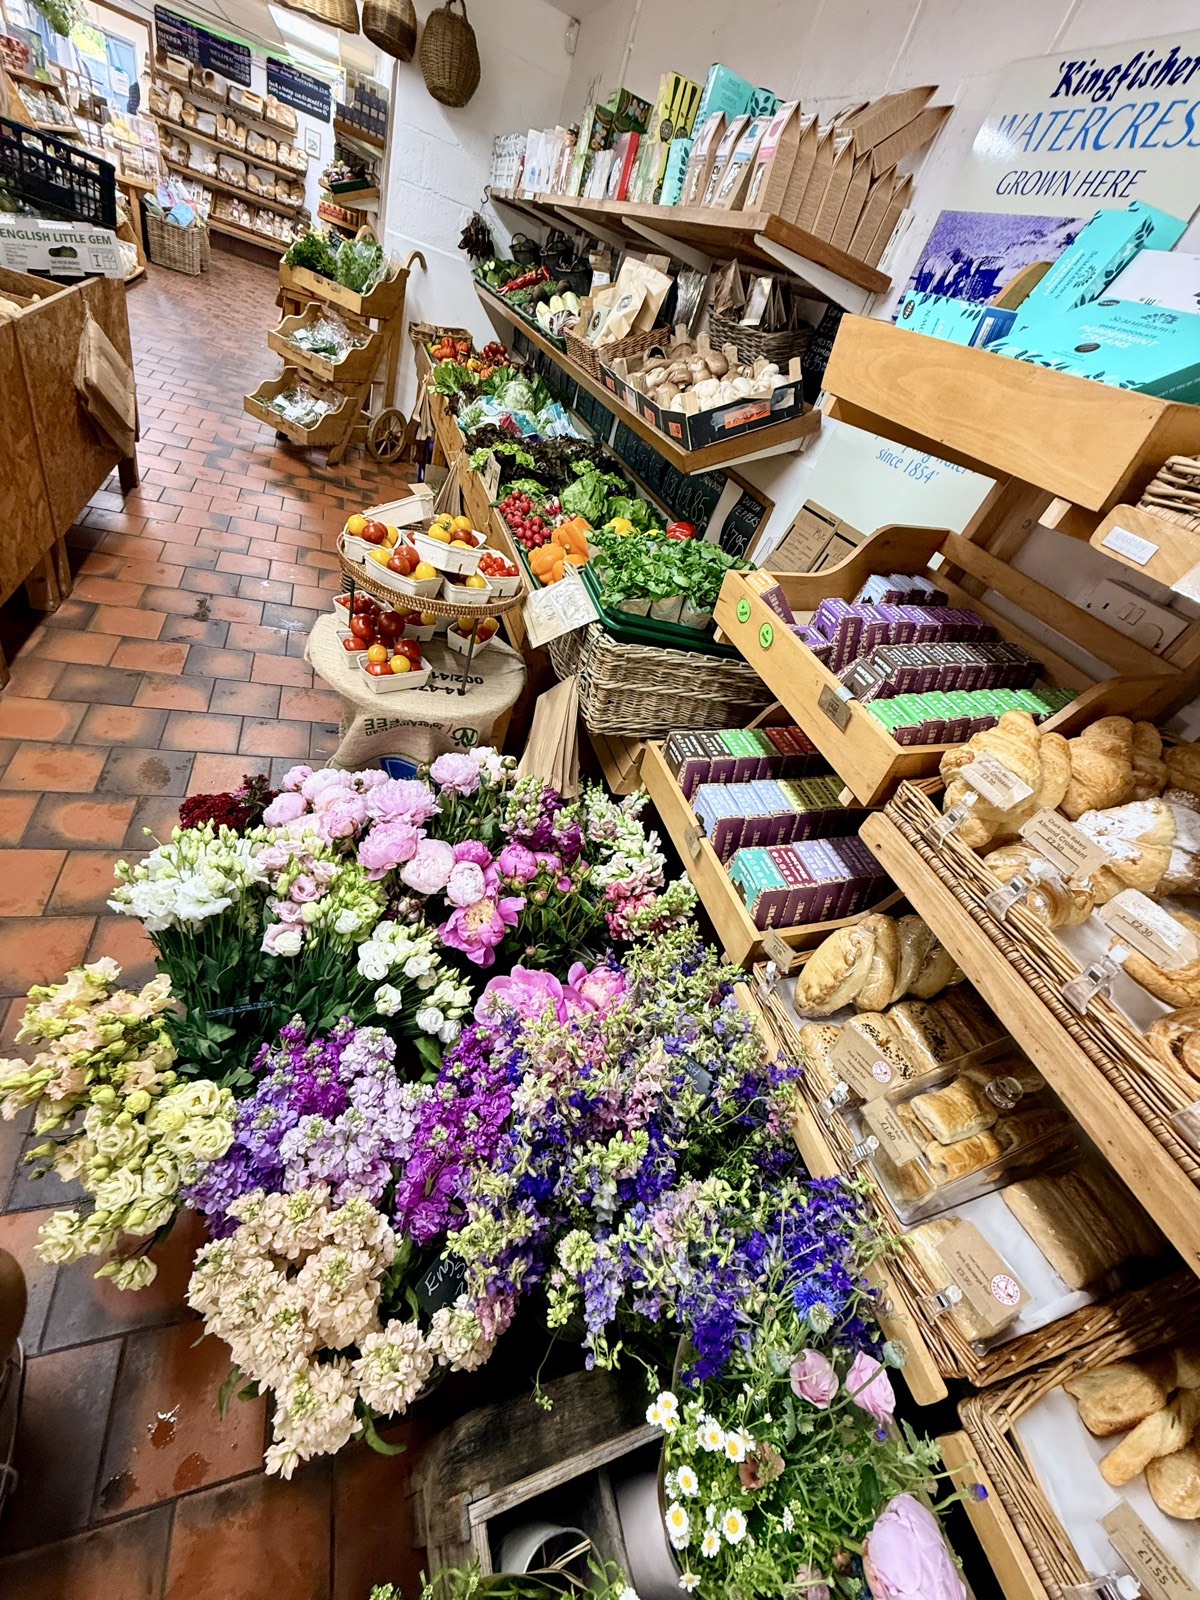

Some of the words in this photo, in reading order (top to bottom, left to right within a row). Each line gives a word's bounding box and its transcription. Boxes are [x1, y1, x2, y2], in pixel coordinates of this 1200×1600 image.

[996, 170, 1080, 196] GROWN
[1073, 170, 1146, 198] HERE
[0, 228, 51, 242] ENGLISH
[53, 233, 86, 244] LITTLE
[88, 235, 112, 245] GEM
[876, 448, 903, 468] since
[733, 504, 761, 528] PEPPERS
[1038, 819, 1059, 837] Almond
[1059, 835, 1086, 859] Croissant
[1046, 836, 1063, 851] £2.30
[1048, 818, 1060, 829] Chalk
[1070, 836, 1086, 851] Bakery
[1131, 918, 1152, 937] £2.30
[880, 1121, 896, 1140] £1.60
[884, 1116, 895, 1130] Sausage
[899, 1130, 910, 1143] Bakery
[955, 1251, 966, 1262] Pork
[964, 1263, 983, 1285] Sausage
[982, 1285, 991, 1296] Roll
[1141, 1539, 1163, 1564] Cheese
[1137, 1549, 1168, 1584] £1.55
[1170, 1566, 1193, 1591] Bakery
